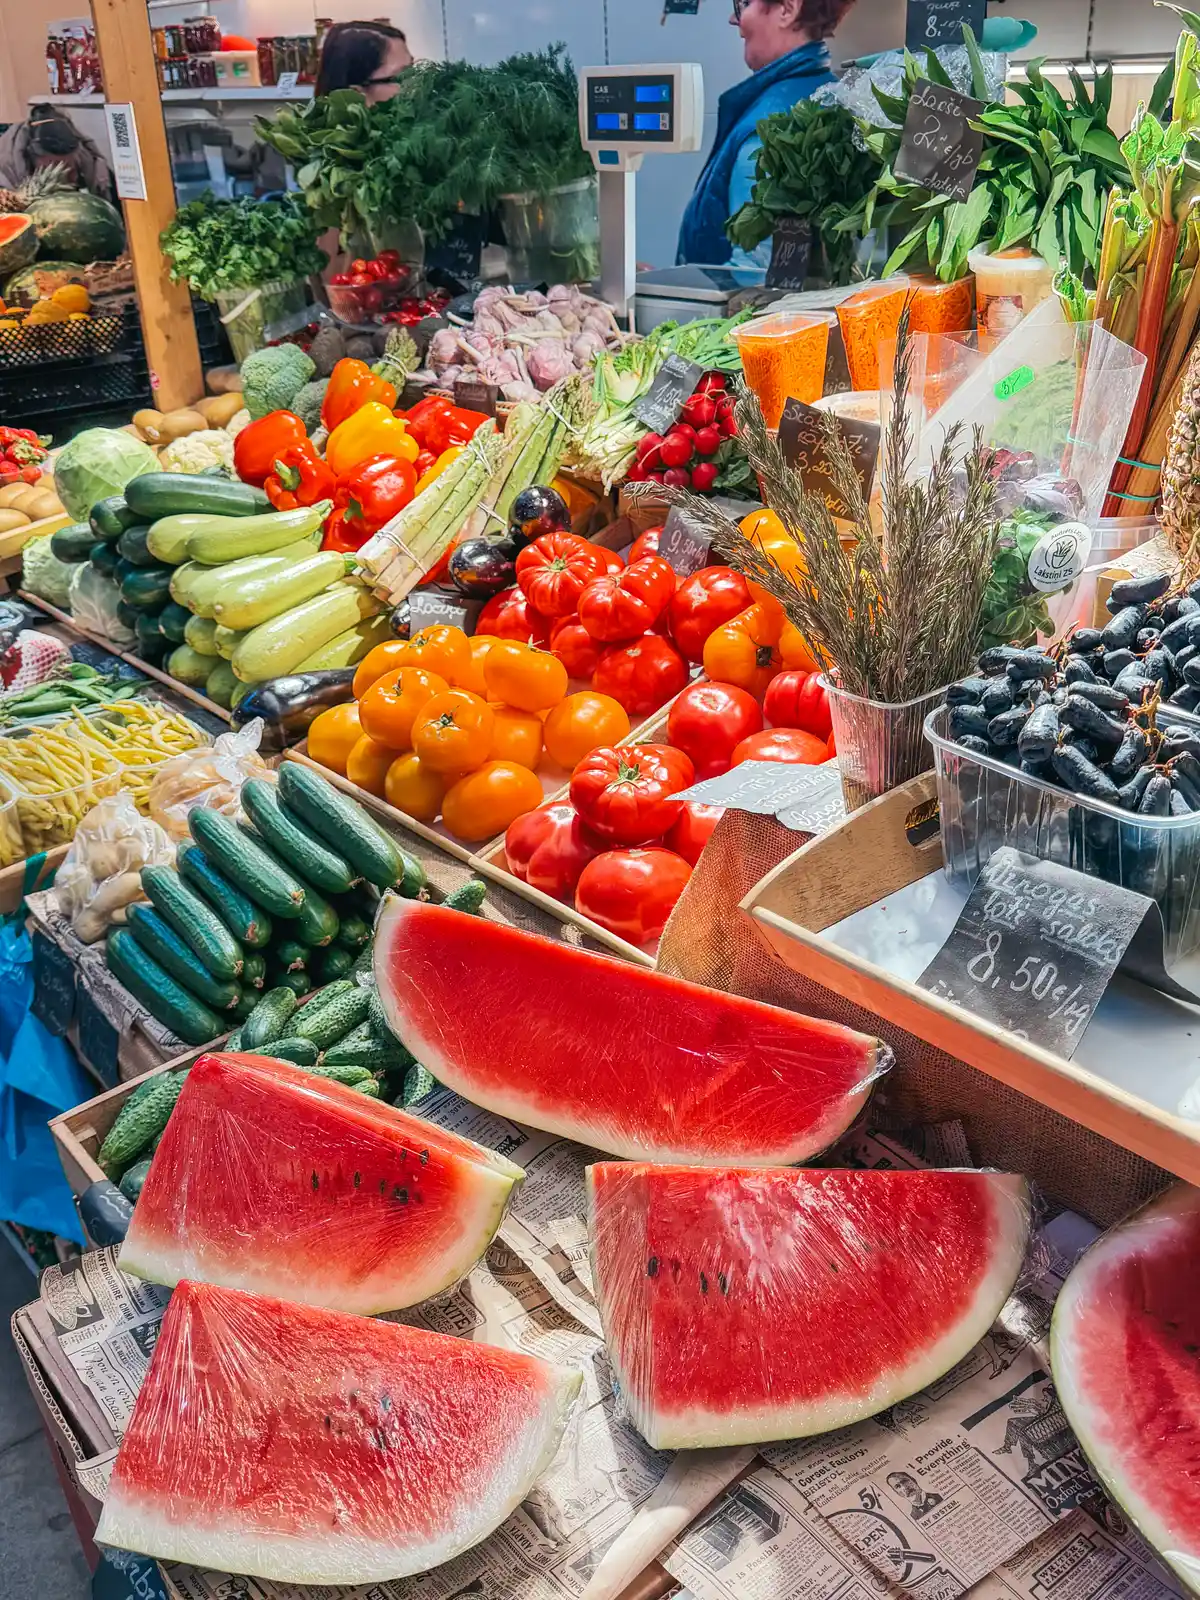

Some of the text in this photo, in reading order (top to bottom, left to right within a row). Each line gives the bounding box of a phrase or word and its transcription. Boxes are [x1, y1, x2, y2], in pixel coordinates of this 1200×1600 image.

[594, 86, 609, 94] CAS
[93, 1247, 125, 1301] TAFFORDSHIRE
[915, 1435, 952, 1465] Provide
[797, 1463, 831, 1488] Corset
[829, 1445, 869, 1469] Factory,
[1044, 1476, 1082, 1510] Oxford
[859, 1523, 889, 1547] PEN
[920, 1516, 932, 1528] MY
[746, 1541, 779, 1571] Possible
[559, 1568, 584, 1594] Believe
